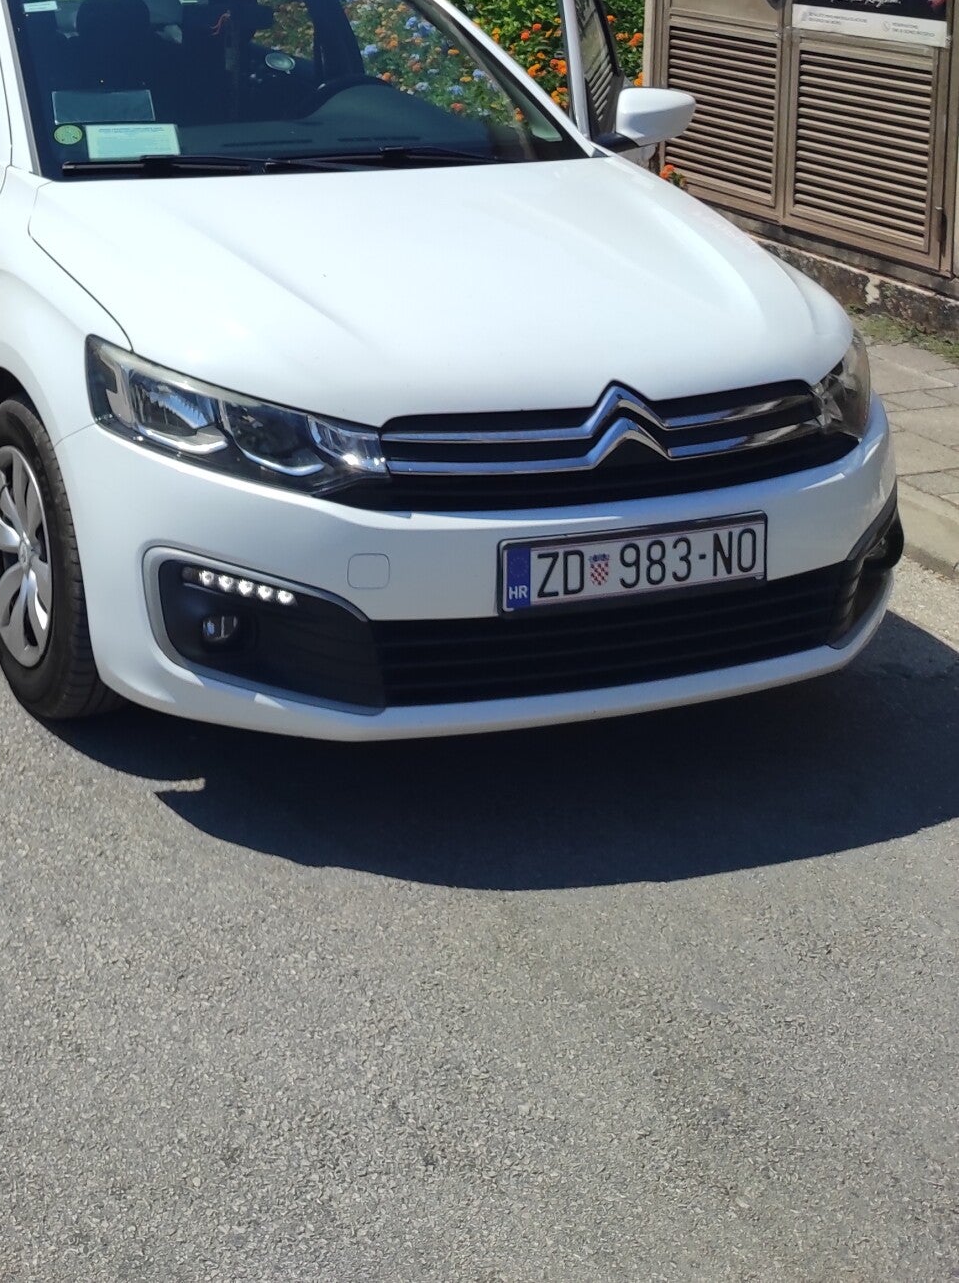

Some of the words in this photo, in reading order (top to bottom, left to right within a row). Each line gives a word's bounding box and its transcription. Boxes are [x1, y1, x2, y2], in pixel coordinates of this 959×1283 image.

[537, 549, 585, 598] ZD
[619, 528, 757, 589] 983-NO
[508, 585, 528, 600] HR
